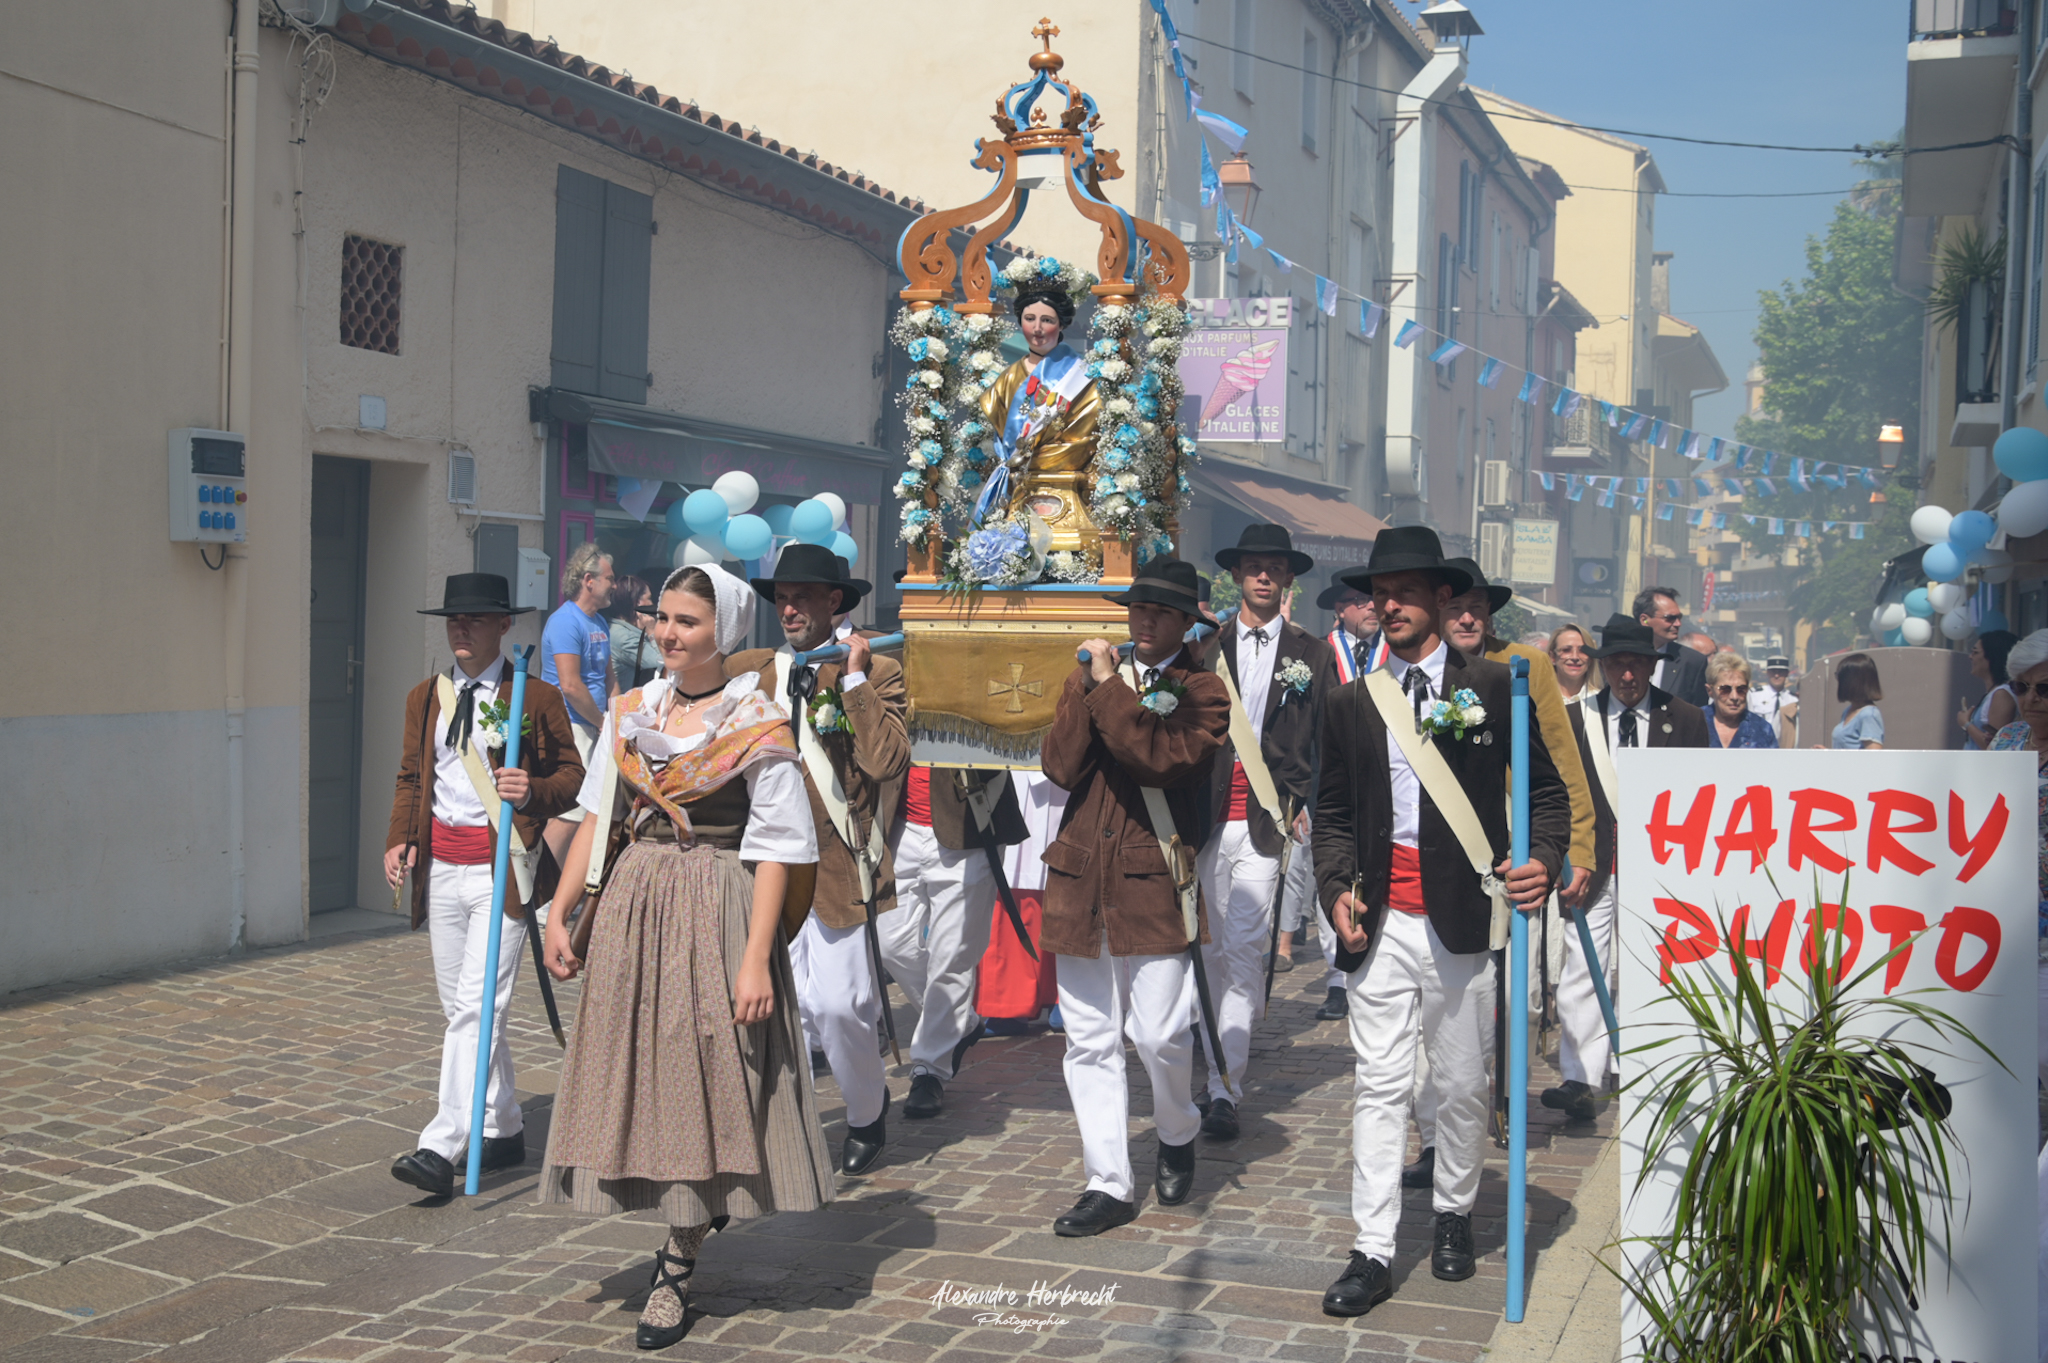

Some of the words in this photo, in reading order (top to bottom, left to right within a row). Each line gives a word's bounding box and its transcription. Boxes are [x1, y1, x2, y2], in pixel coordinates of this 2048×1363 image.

[1187, 299, 1289, 327] GLACE
[1183, 333, 1204, 344] AUX
[1208, 333, 1258, 344] PARFUMS
[1182, 346, 1227, 357] D'ITALIE
[1225, 404, 1280, 417] GLACES
[1194, 419, 1279, 433] L'ITALIENNE
[1645, 783, 2010, 884] HARRY
[1652, 897, 2002, 995] PHOTO
